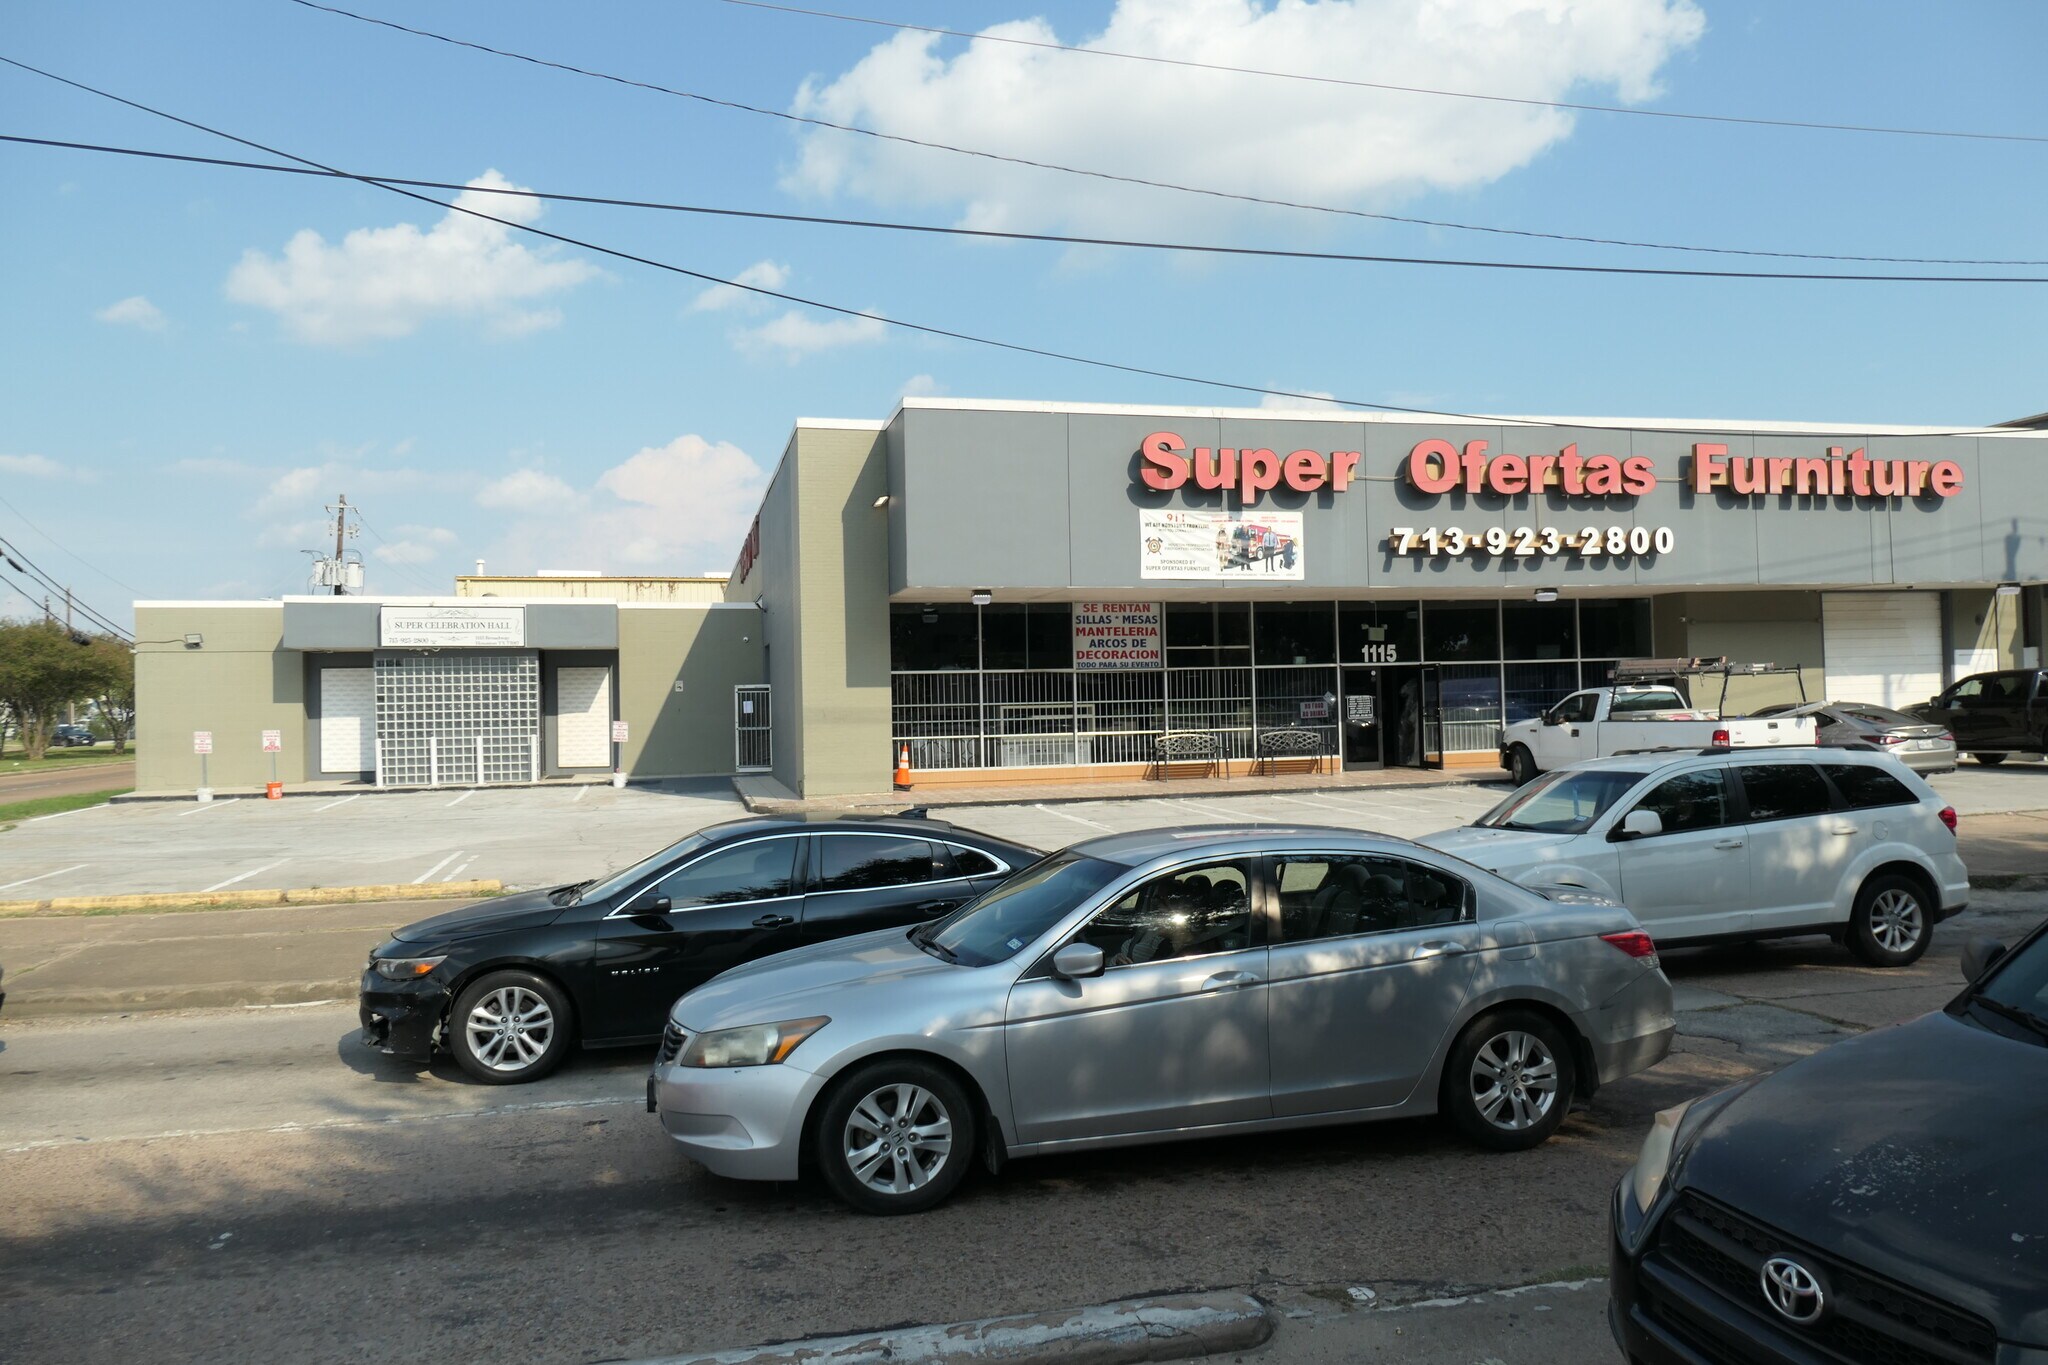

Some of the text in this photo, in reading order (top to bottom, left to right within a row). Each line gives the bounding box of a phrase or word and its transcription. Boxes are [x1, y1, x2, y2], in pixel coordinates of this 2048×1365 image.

[1140, 431, 1965, 505] Super Ofertas Furniture
[1083, 603, 1151, 613] SE RENTAN
[1075, 615, 1158, 625] SILLAS MESAS
[1076, 627, 1158, 637] MANTELERIA
[1089, 639, 1147, 648] ARCOS DE
[1076, 650, 1159, 660] DECORACION
[1361, 644, 1397, 662] 1115
[611, 966, 660, 976] MALIBU
